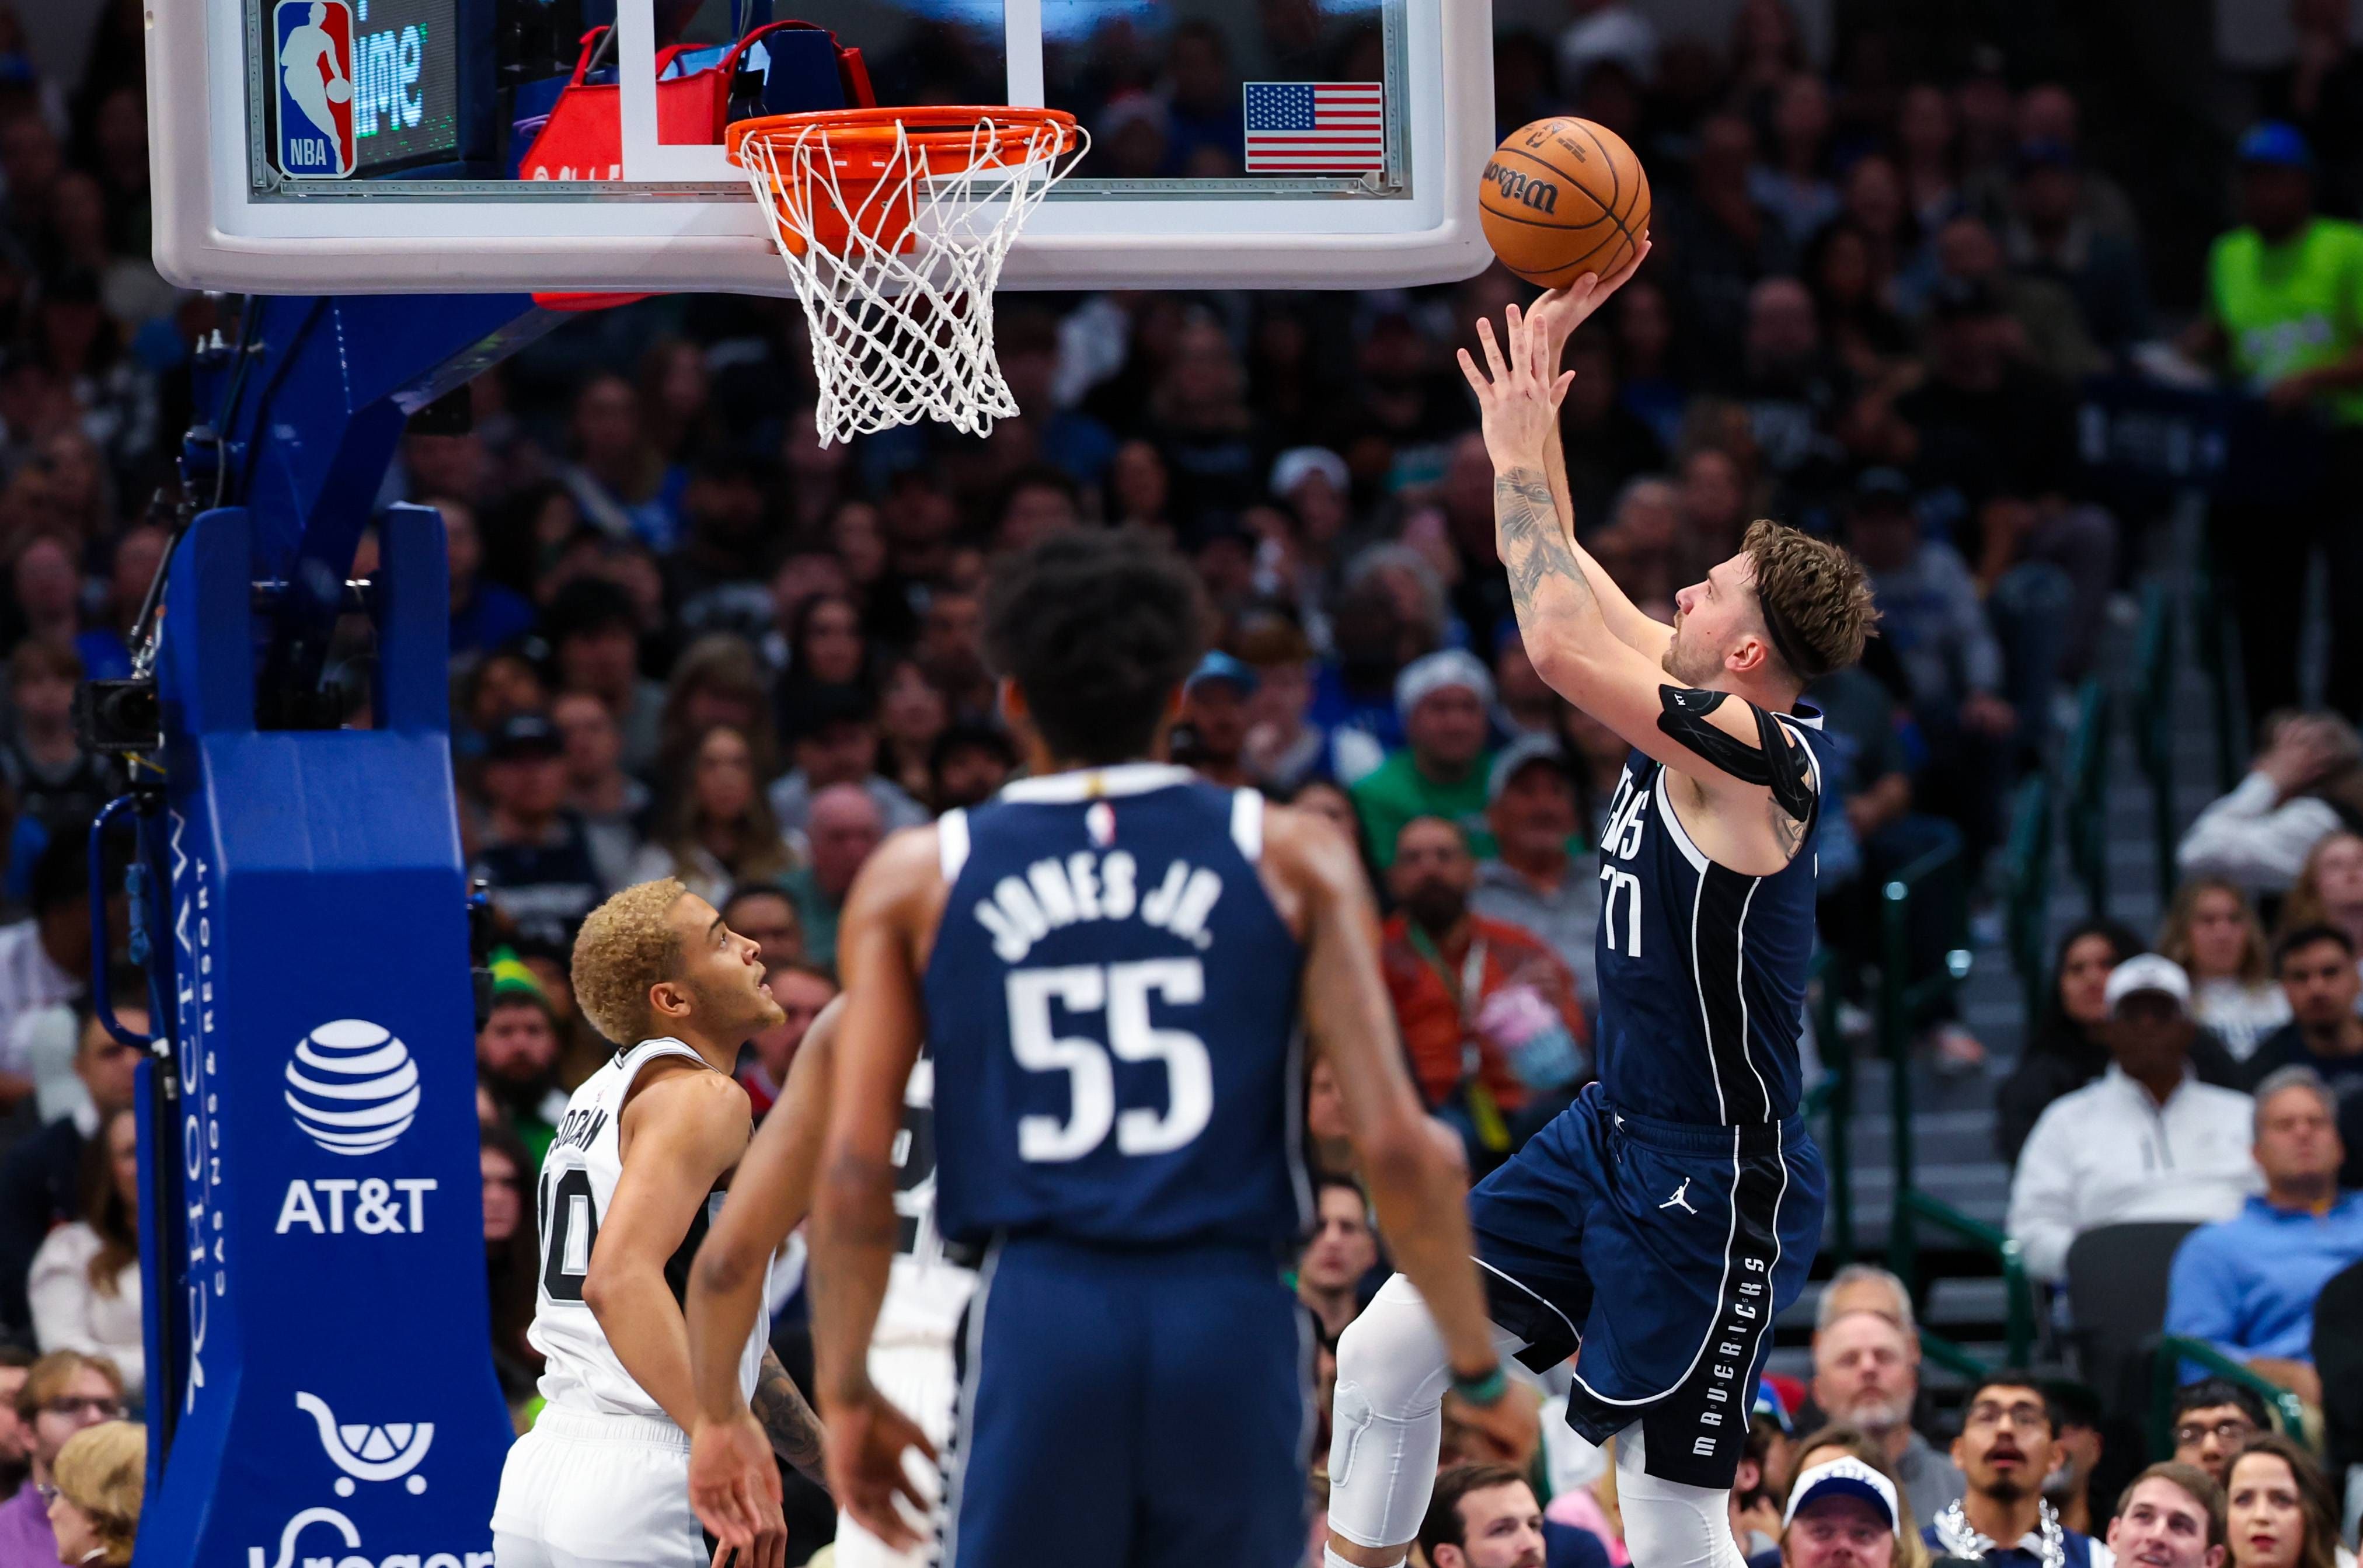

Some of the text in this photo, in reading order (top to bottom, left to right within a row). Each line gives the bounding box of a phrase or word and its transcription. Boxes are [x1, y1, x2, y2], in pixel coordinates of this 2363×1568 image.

[291, 138, 327, 166] NBA
[1674, 694, 1686, 706] KT
[196, 856, 215, 1033] RESORT
[973, 850, 1224, 964] JONES JR.
[1599, 864, 1641, 958] 77
[168, 808, 207, 1353] CHOCTAW
[205, 1051, 217, 1076] &
[1005, 957, 1215, 1163] 55
[276, 1178, 438, 1234] AT&T
[1692, 1257, 1765, 1457] MAVERICKS
